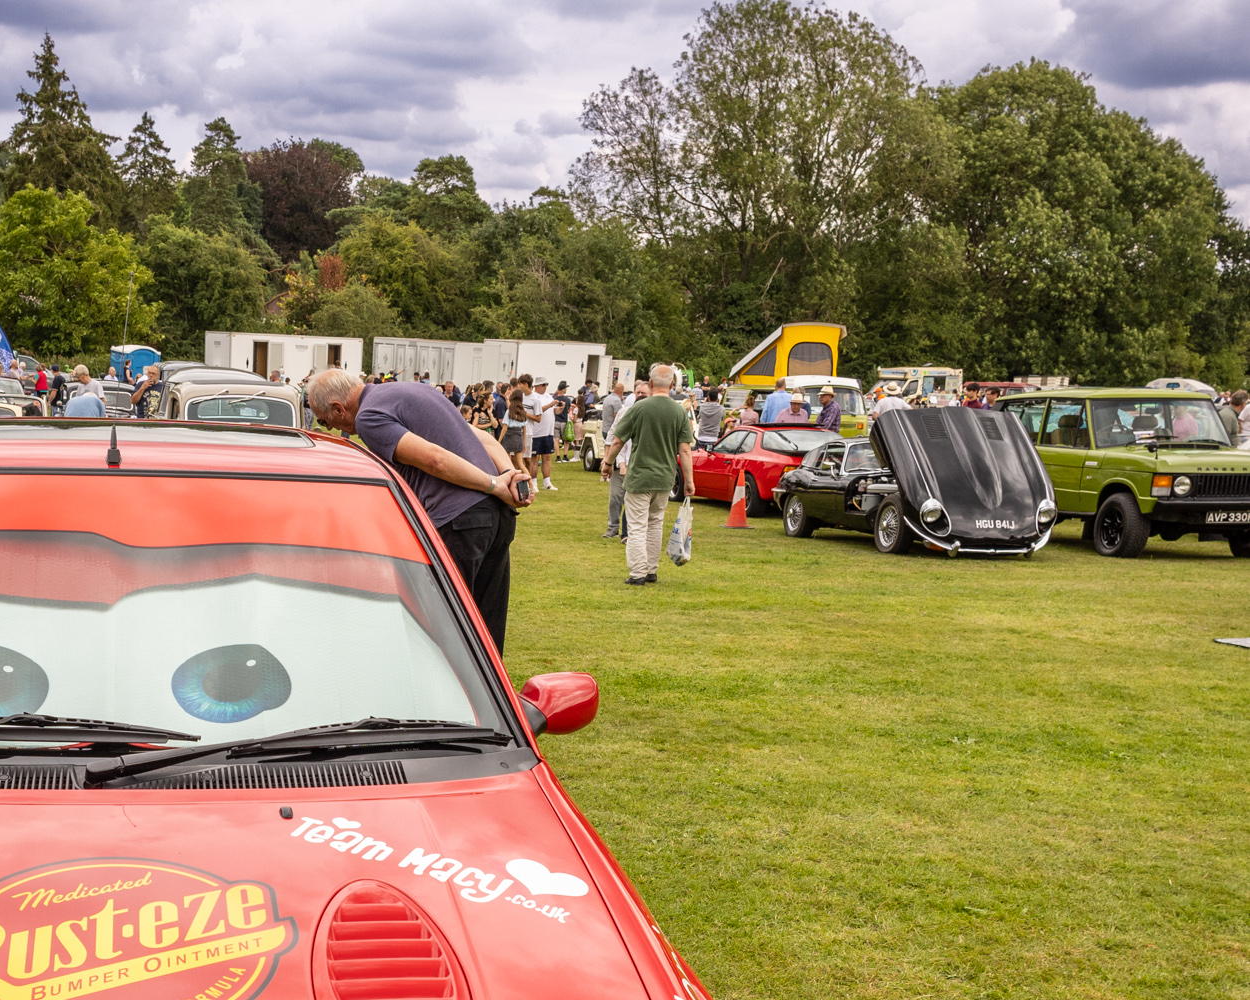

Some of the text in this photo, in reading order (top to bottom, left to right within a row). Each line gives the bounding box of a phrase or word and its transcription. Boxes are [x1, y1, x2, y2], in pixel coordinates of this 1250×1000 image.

[975, 519, 1015, 530] HGU 841J
[1207, 512, 1228, 522] AVP
[290, 816, 394, 861] Team
[11, 871, 153, 911] Medicated
[143, 937, 264, 974] OINTMENT
